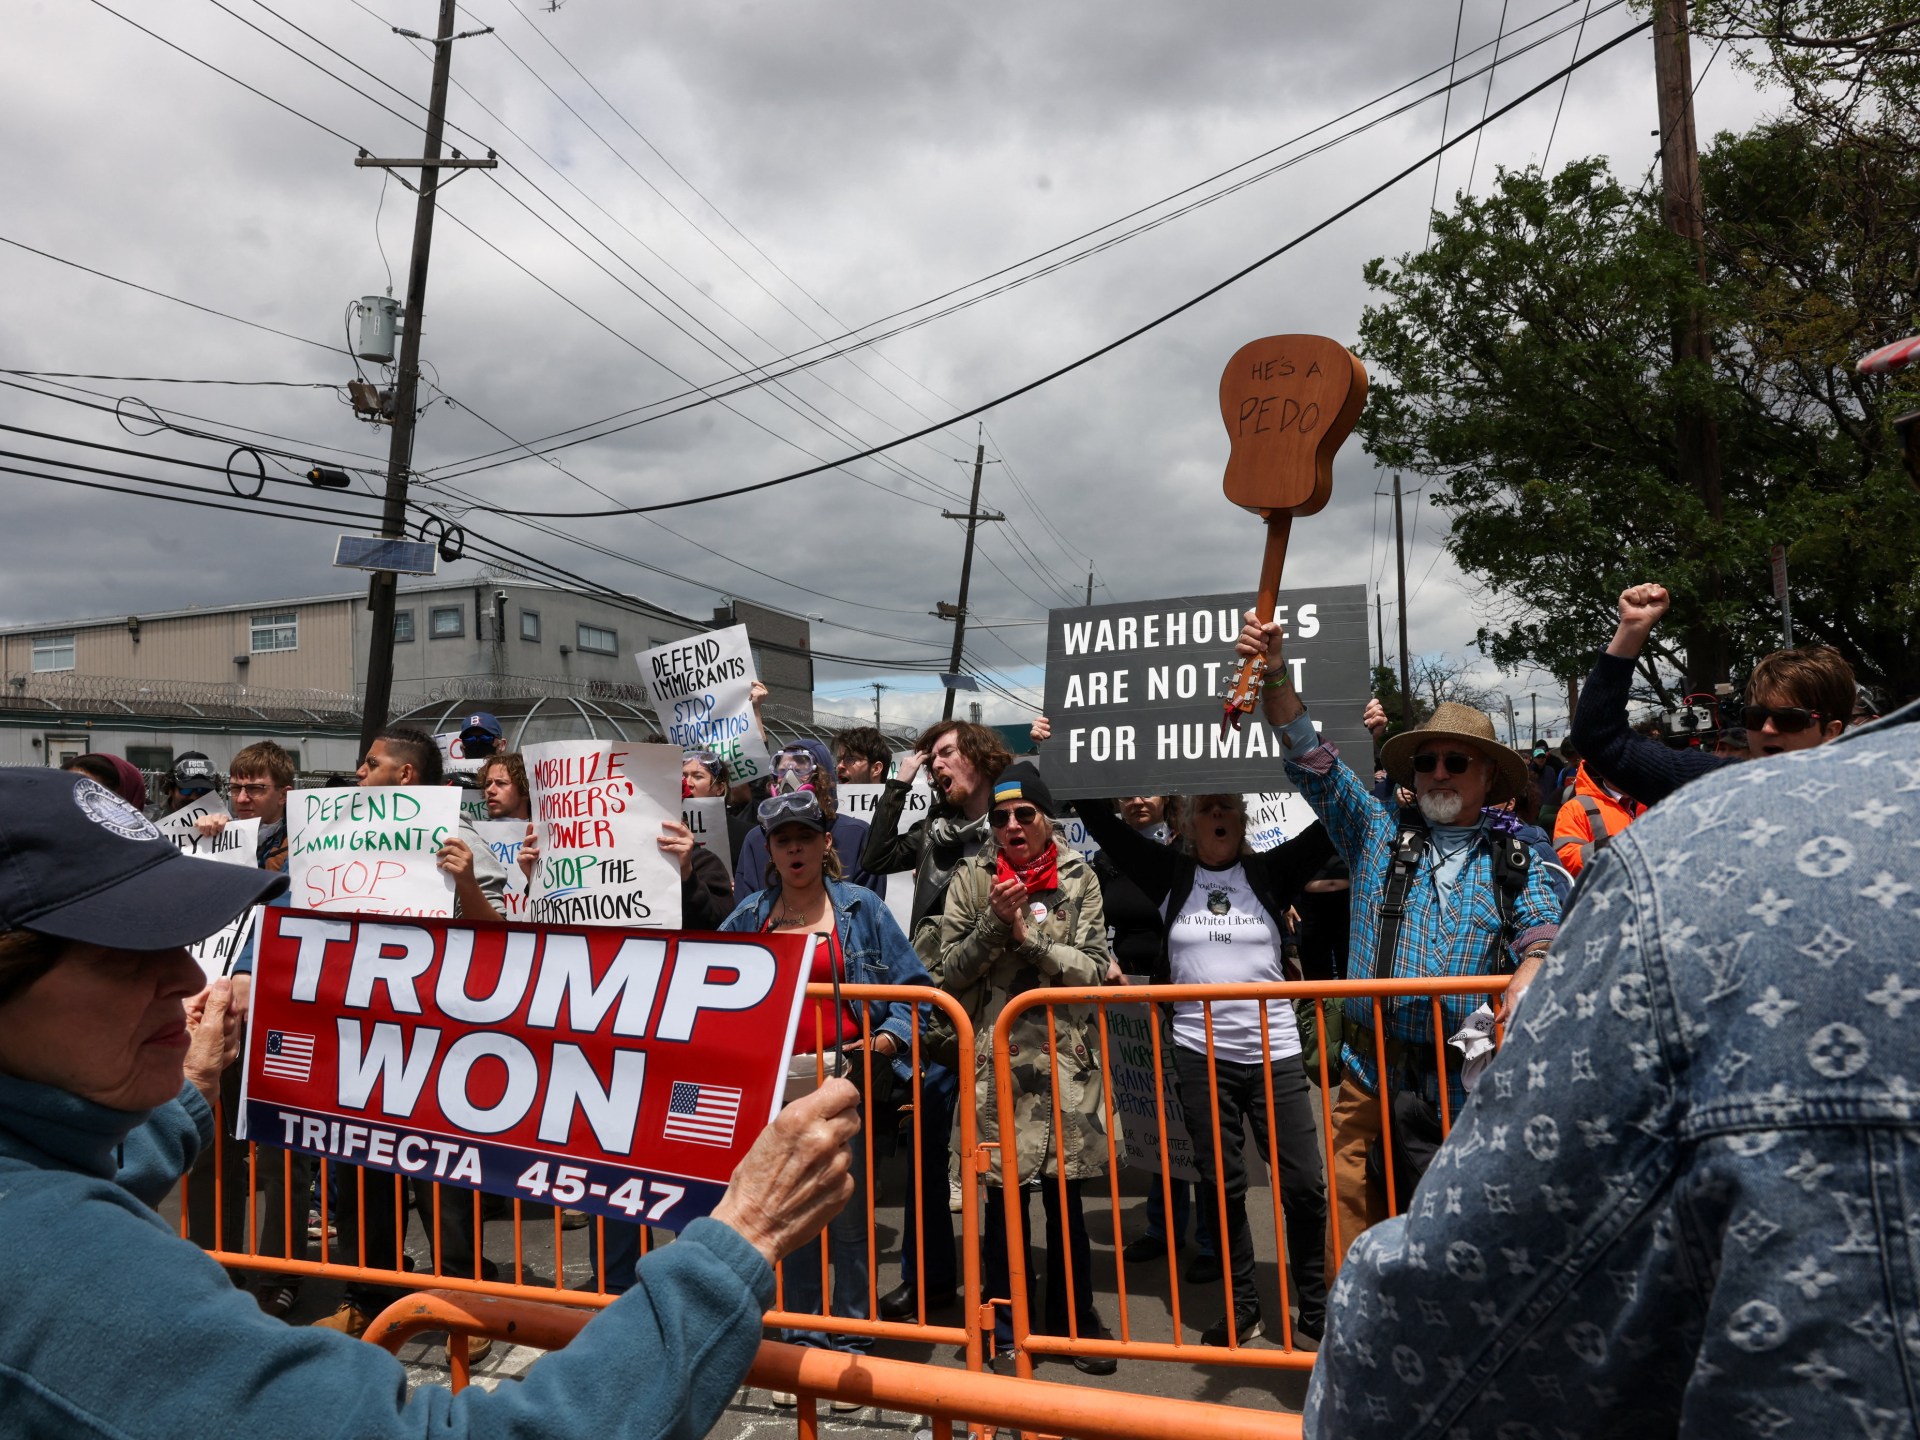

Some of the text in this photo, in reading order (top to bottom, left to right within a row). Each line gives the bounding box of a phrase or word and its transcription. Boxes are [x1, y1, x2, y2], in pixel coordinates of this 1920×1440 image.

[1252, 355, 1322, 381] HE'S A
[1238, 396, 1320, 437] PEDO
[1063, 603, 1321, 655] WAREHOUES
[651, 638, 720, 679] DEFEND
[652, 656, 745, 701] IMMIGRANTS
[1063, 662, 1221, 709] ARE NOT
[470, 715, 480, 726] B
[674, 694, 716, 723] STOP
[669, 711, 749, 748] DEPORTATIONS
[1069, 725, 1136, 763] FOR
[534, 751, 630, 791] MOBILIZE
[304, 792, 421, 825] DEFEND
[538, 781, 634, 822] WORKERS'
[211, 829, 242, 854] HALL
[292, 826, 449, 857] IMMIGRANTS
[547, 819, 615, 851] POWER
[305, 861, 406, 908] STOP
[535, 854, 637, 889] TO STOP THE
[530, 890, 651, 924] DEPORTATIONS
[1176, 914, 1265, 926] Old White Liberal
[1209, 931, 1232, 944] Hag
[277, 915, 777, 1044] TRUMP
[1106, 1010, 1151, 1044] HEALTH
[335, 1016, 646, 1155] WON
[277, 1111, 687, 1222] TRIFECTA 45-47
